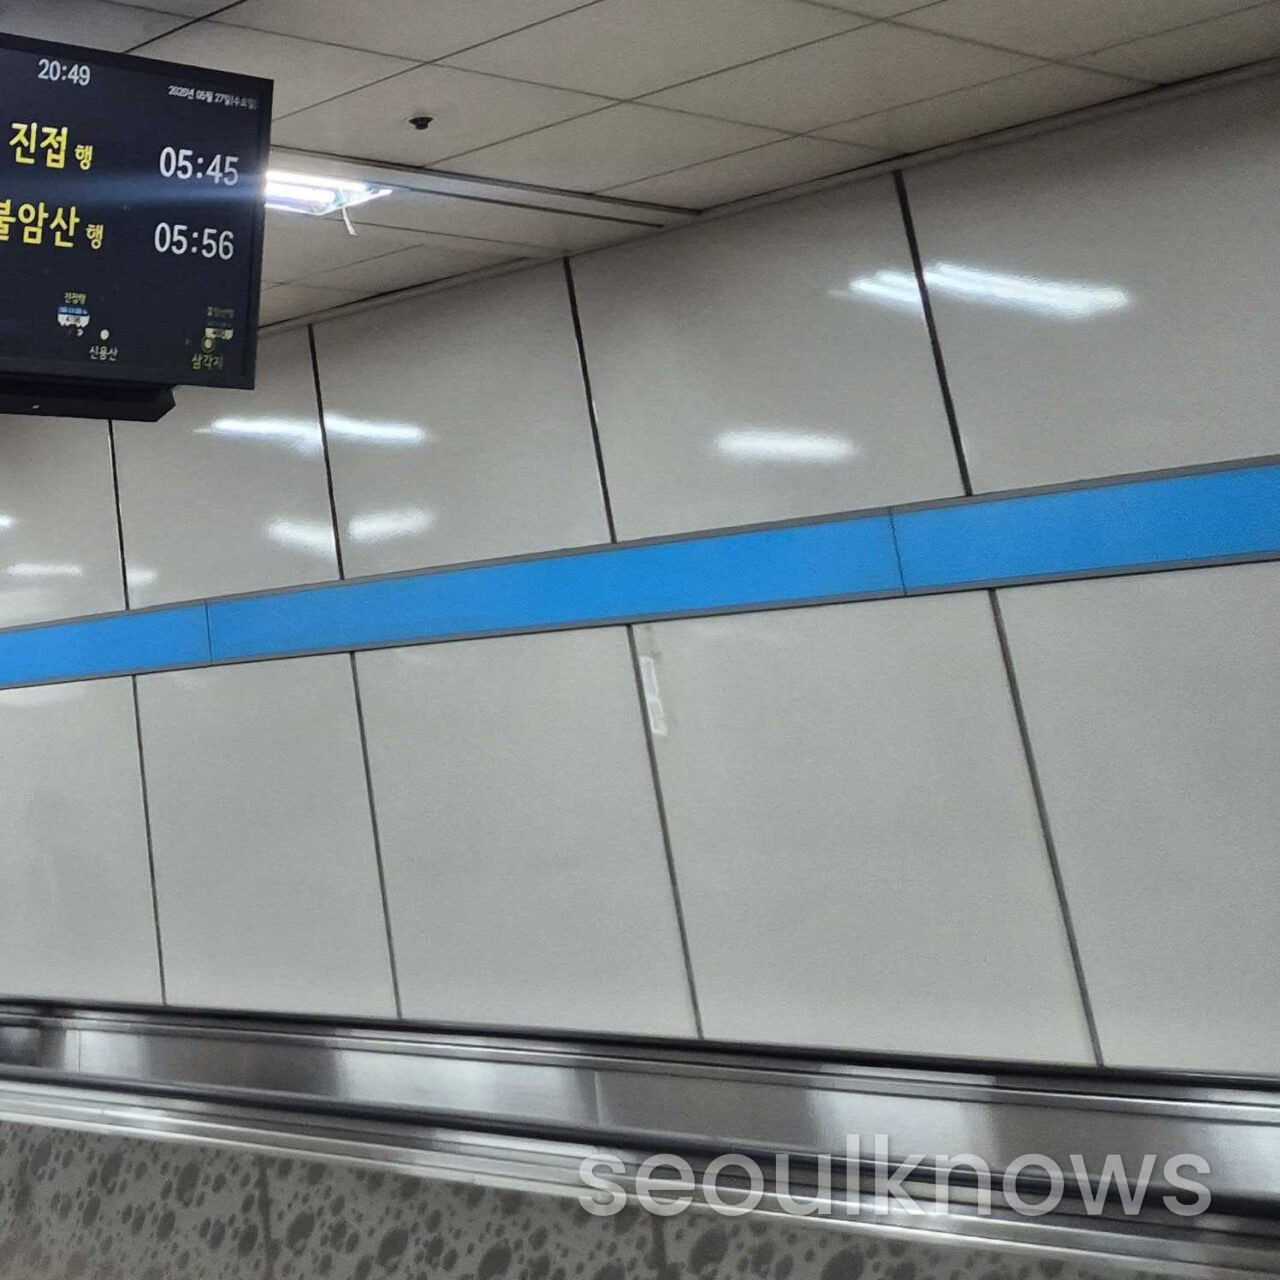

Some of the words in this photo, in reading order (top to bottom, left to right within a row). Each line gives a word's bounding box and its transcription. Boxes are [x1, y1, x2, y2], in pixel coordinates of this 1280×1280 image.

[38, 58, 91, 86] 20:49
[8, 121, 68, 168] 진접
[159, 146, 239, 186] 05:45
[154, 221, 235, 261] 05:56
[89, 345, 119, 362] 신용산
[190, 353, 224, 371] 삼각지
